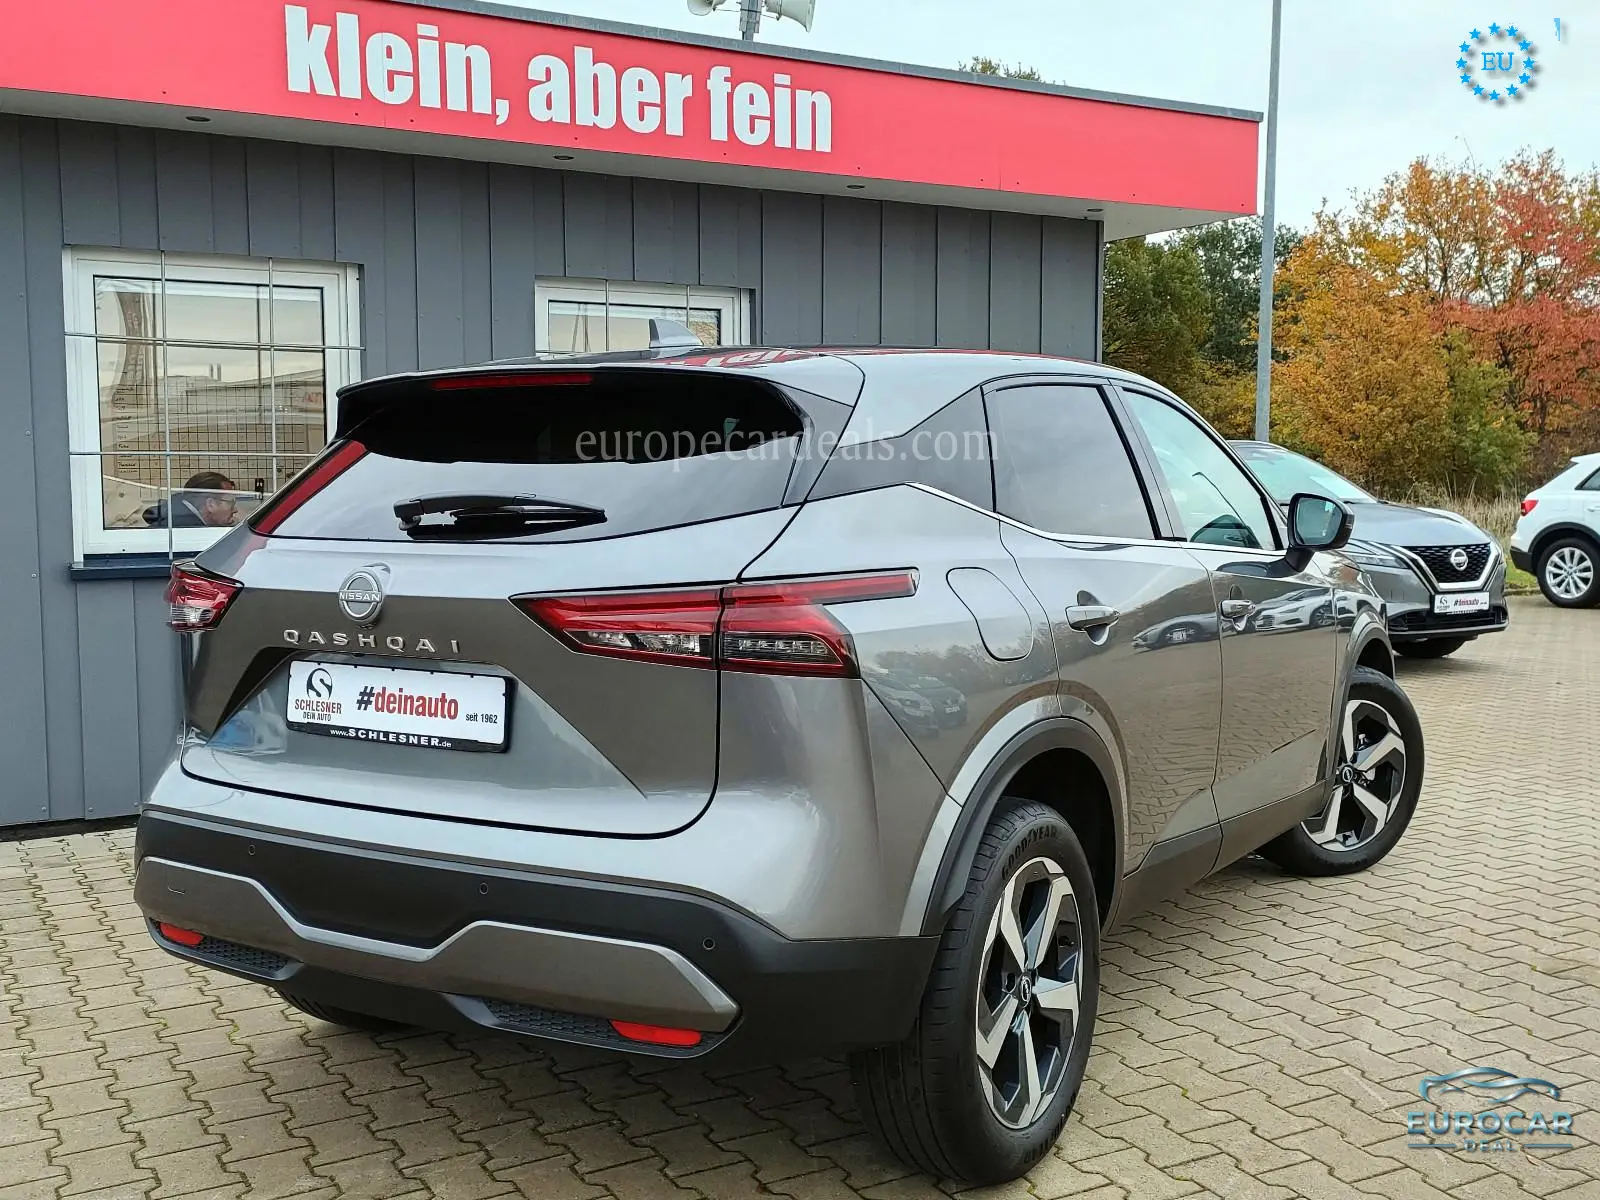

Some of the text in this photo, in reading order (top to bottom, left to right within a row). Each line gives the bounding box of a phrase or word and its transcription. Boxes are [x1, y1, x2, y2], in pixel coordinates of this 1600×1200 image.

[285, 4, 833, 154] klein, aber fein
[339, 591, 381, 602] NISSAN
[283, 629, 461, 653] QASHQAI
[294, 698, 342, 715] SCHLESNER
[356, 685, 459, 720] #deinauto
[302, 711, 332, 722] DEIN AUTO
[465, 712, 498, 724] seit 1962
[330, 728, 452, 748] www.SCHLESNER.de
